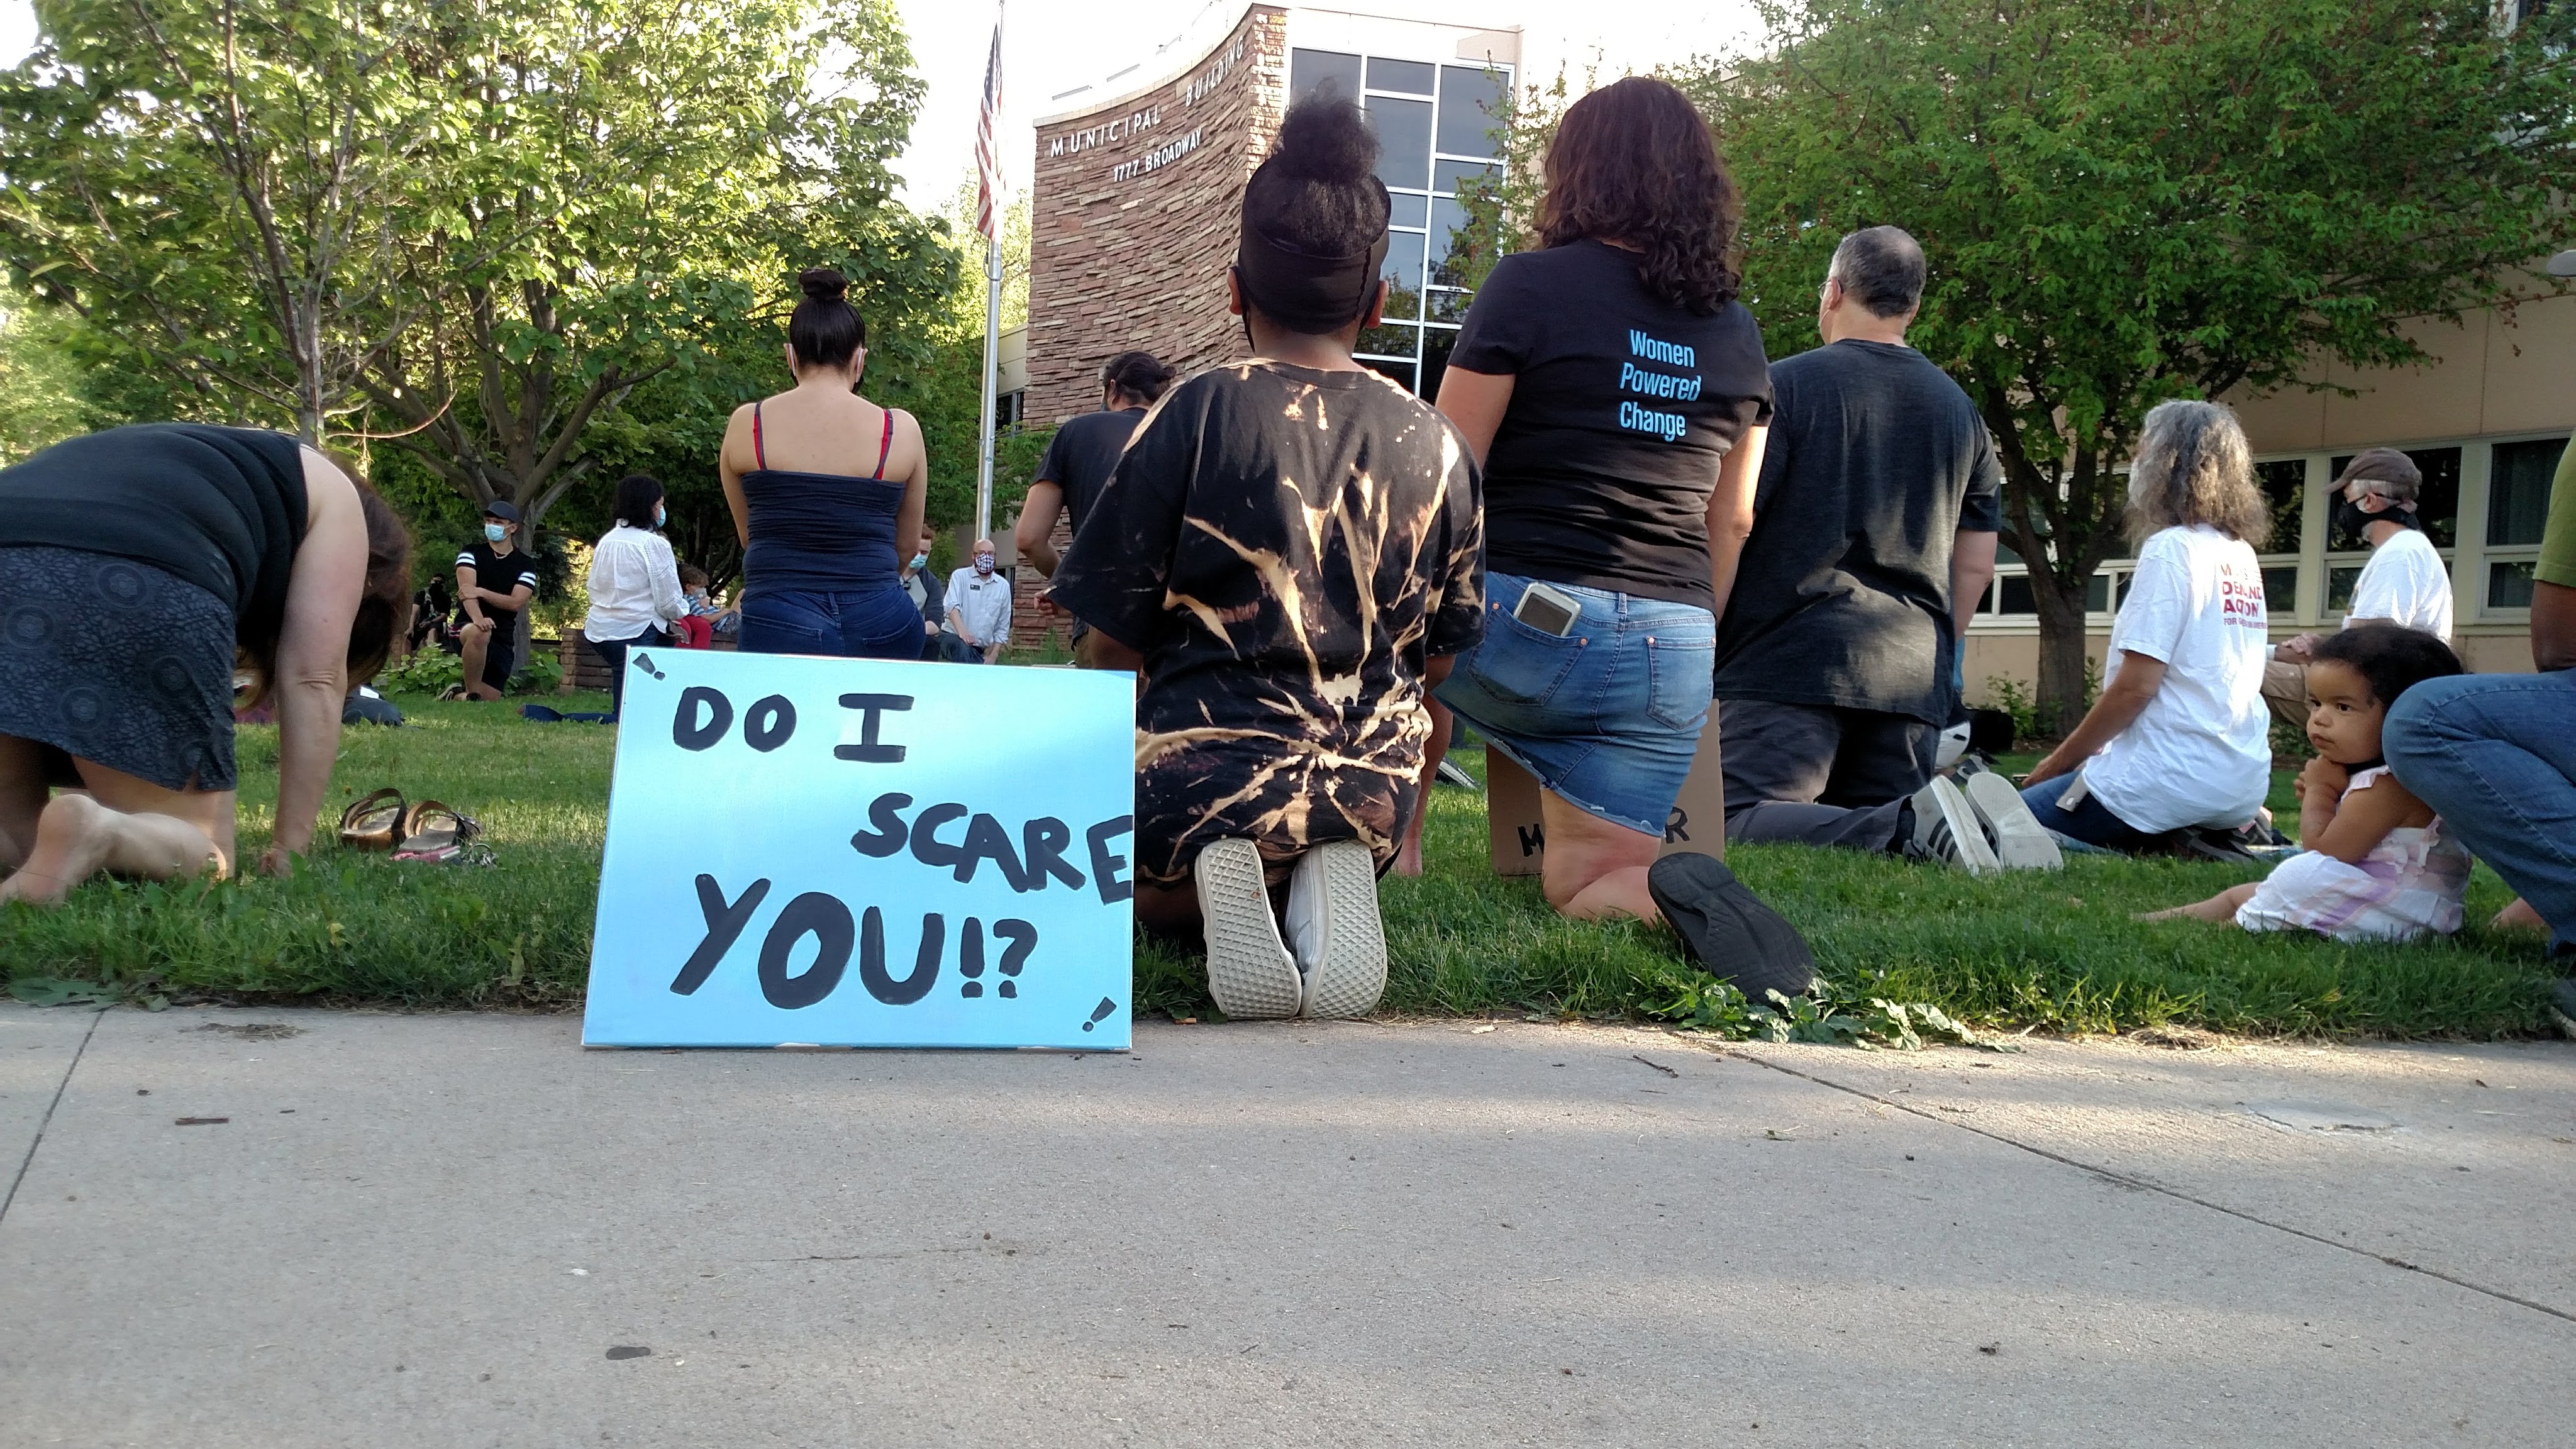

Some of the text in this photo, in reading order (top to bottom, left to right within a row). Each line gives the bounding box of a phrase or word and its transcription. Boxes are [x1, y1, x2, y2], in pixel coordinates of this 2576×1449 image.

[1051, 35, 1243, 158] MUNICIPAL BUILDING
[1113, 126, 1202, 182] 1777 BROADWAY
[1629, 328, 1695, 369] Women
[1619, 362, 1702, 402] Powered
[1619, 401, 1687, 443] Change
[2222, 581, 2262, 600] DEND
[673, 686, 914, 763] DO I
[851, 792, 1135, 906] SCARE
